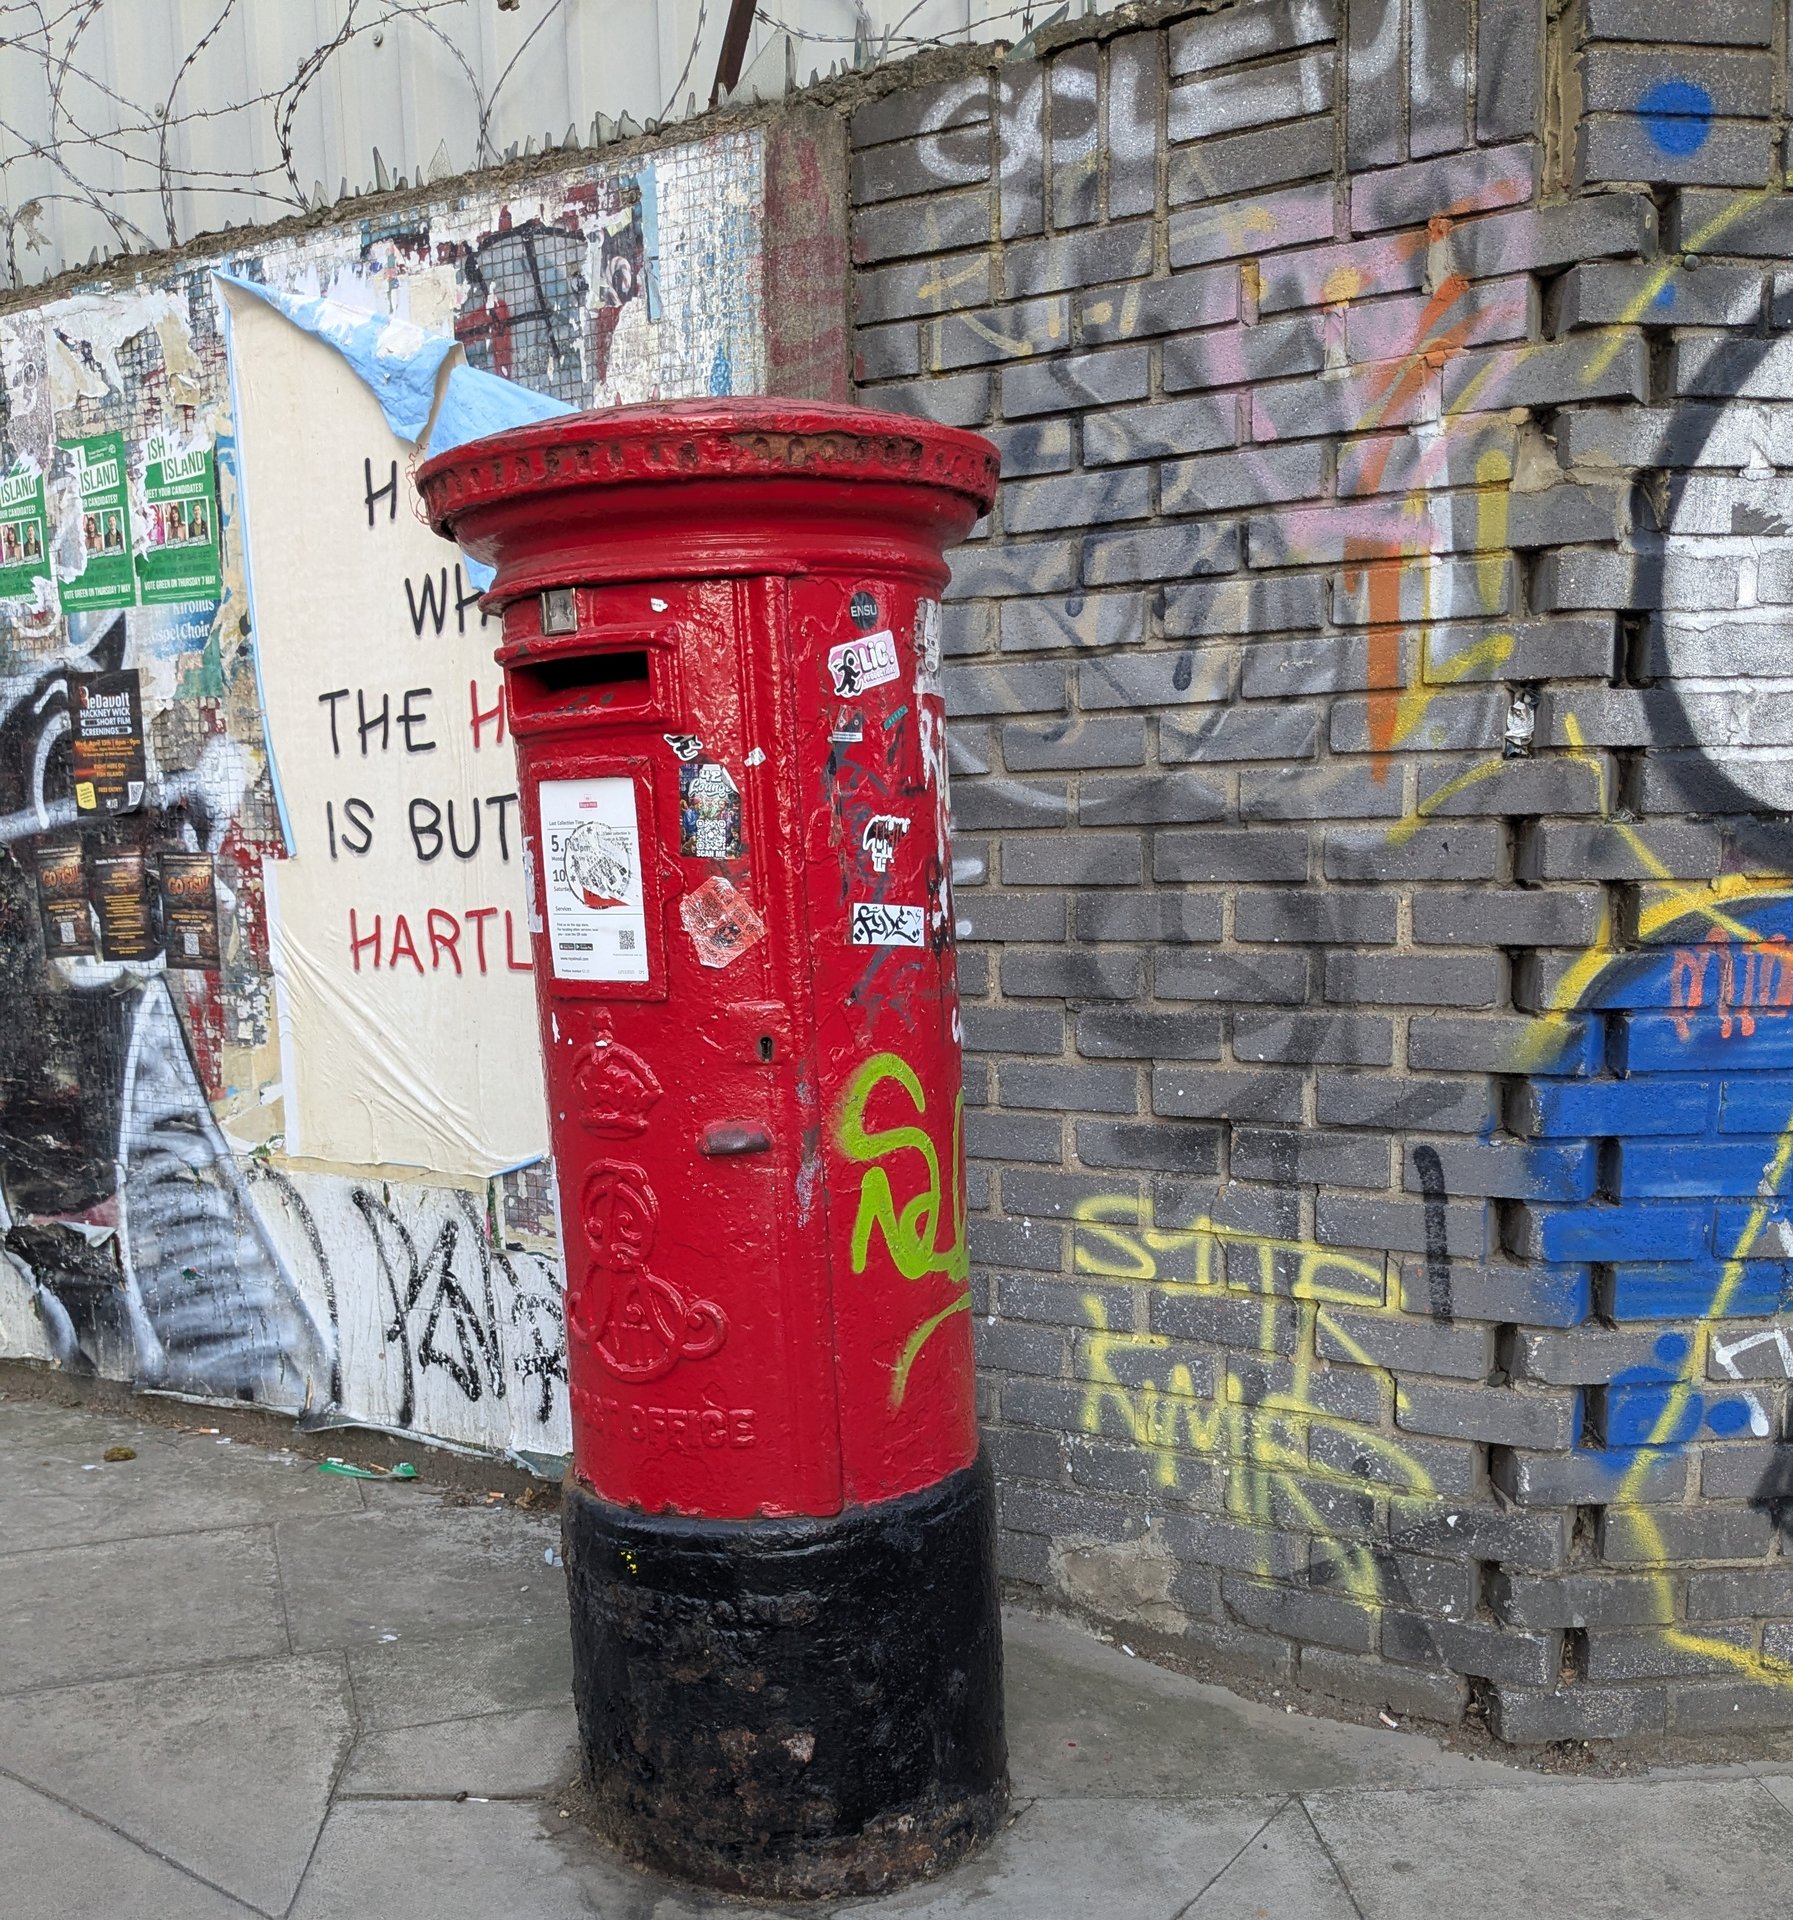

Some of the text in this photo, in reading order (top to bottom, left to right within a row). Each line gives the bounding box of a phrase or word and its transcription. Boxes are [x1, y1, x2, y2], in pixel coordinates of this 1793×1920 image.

[80, 463, 118, 494] ISLAND
[163, 450, 205, 481] ISLAND
[0, 475, 36, 504] ISLAND
[181, 620, 211, 639] Choir
[80, 707, 131, 718] HACKNEY WICK
[97, 716, 132, 726] SHORT FILM
[318, 687, 437, 756] THE
[81, 726, 119, 737] SCREENINGS
[700, 769, 722, 783] 42
[326, 793, 519, 862] IS BUT
[168, 876, 184, 896] GO
[348, 907, 534, 975] HARTL
[629, 1404, 757, 1448] OFFICE
